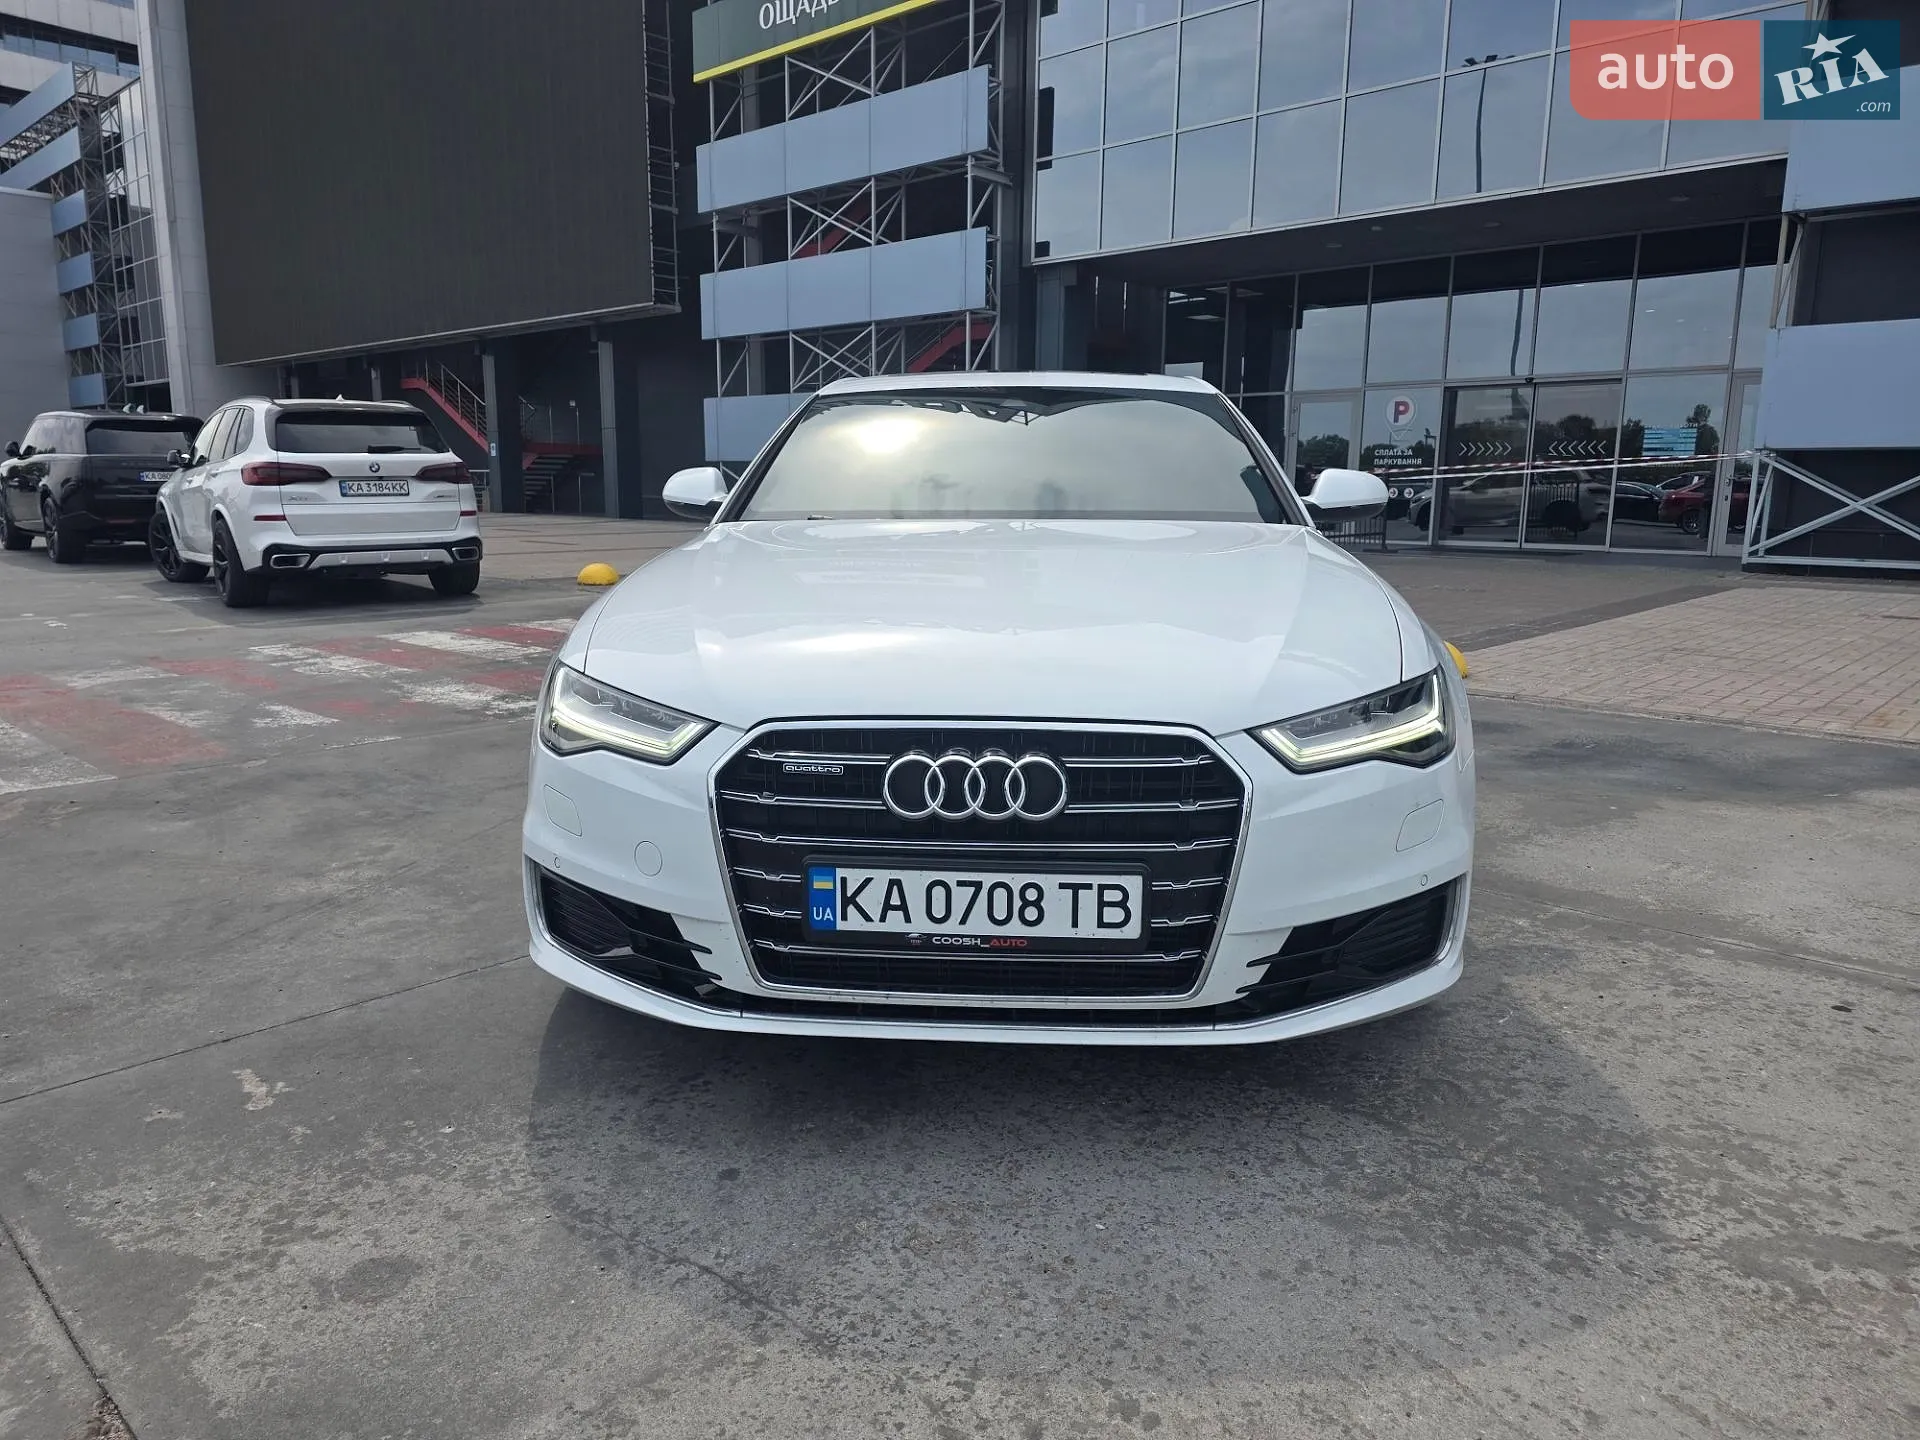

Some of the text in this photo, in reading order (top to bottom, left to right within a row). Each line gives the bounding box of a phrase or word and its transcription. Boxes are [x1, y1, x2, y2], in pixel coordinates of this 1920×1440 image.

[759, 0, 840, 29] ОЩАД
[1393, 400, 1410, 424] P
[1374, 448, 1413, 456] СПЛАТА ЗА
[366, 482, 391, 492] 3184
[785, 765, 841, 773] quattro
[839, 876, 1132, 929] KA 0708 TB
[813, 906, 834, 921] UA
